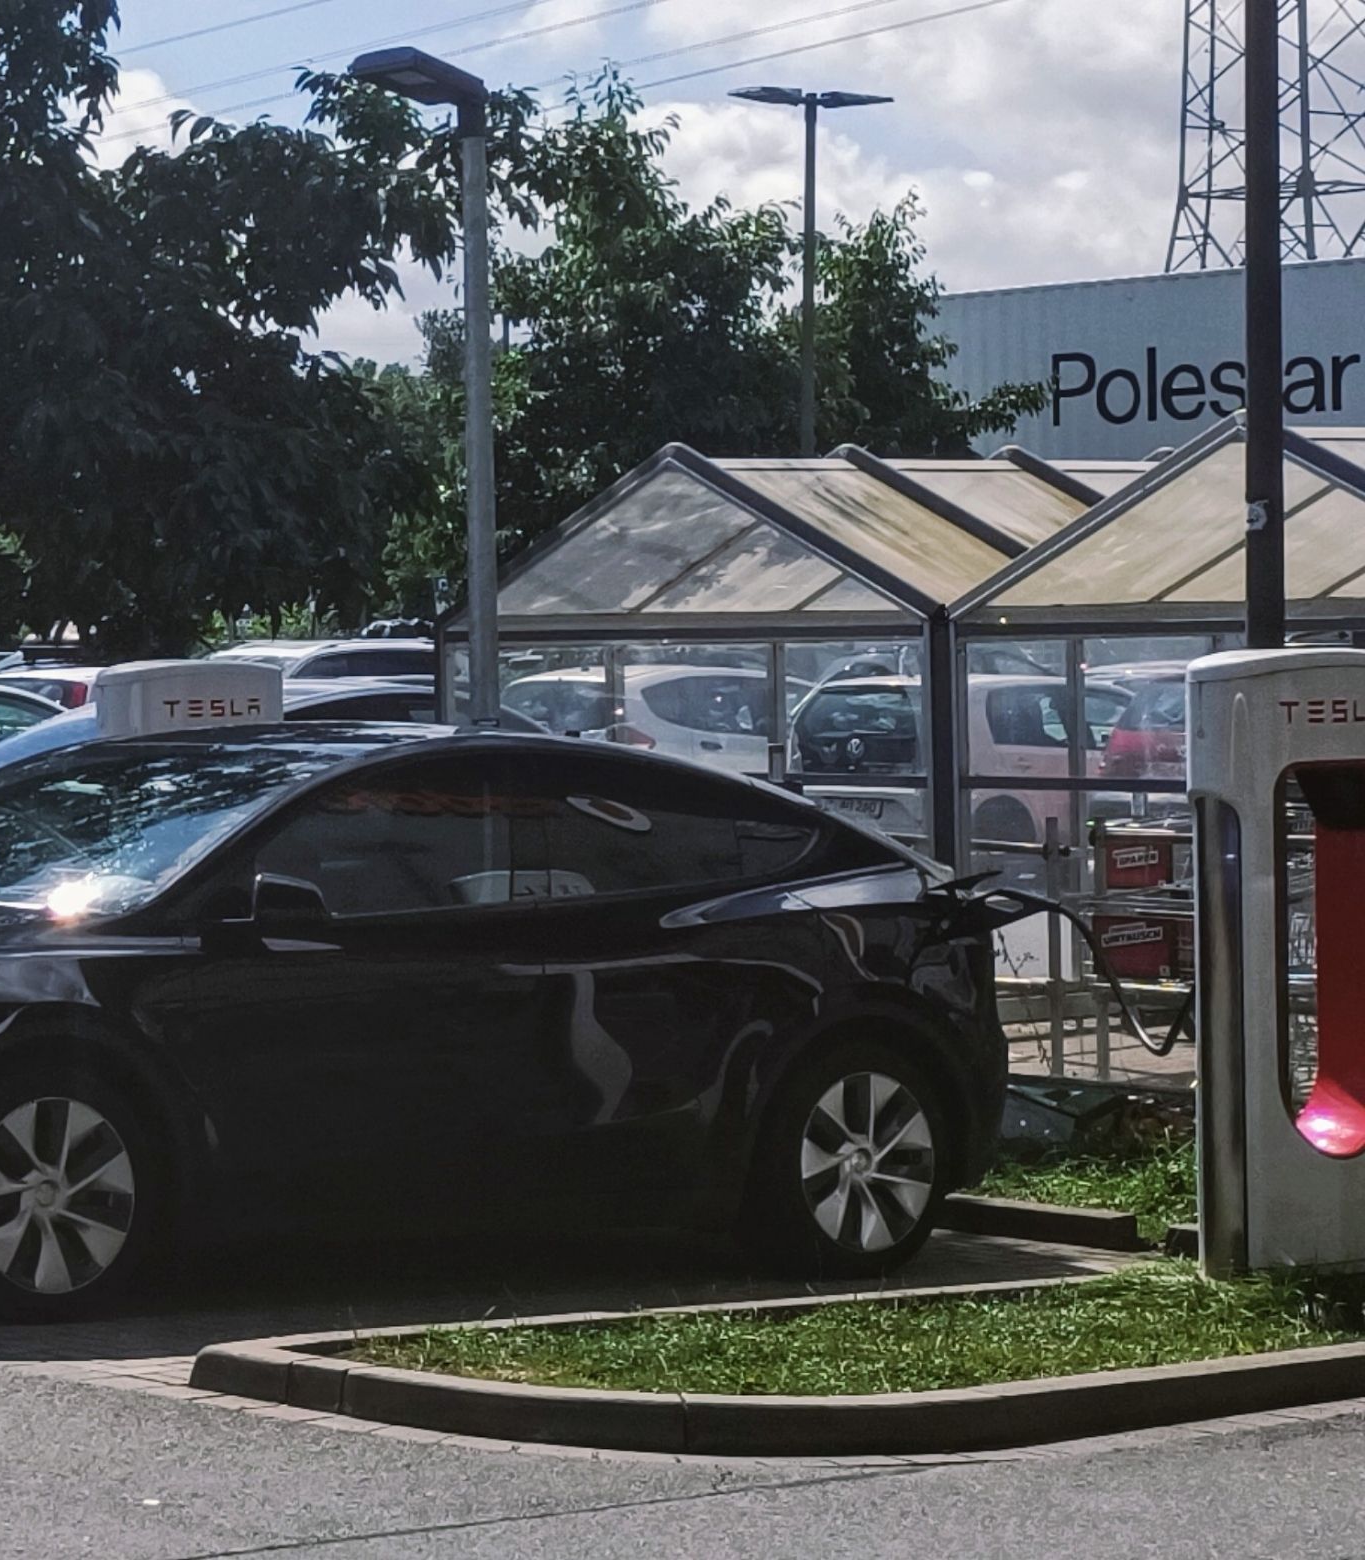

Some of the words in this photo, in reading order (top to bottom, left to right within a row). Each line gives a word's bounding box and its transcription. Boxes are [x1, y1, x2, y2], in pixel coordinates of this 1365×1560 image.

[1052, 347, 1361, 426] Polesar
[163, 698, 261, 718] TESLA
[1279, 700, 1365, 723] TESL
